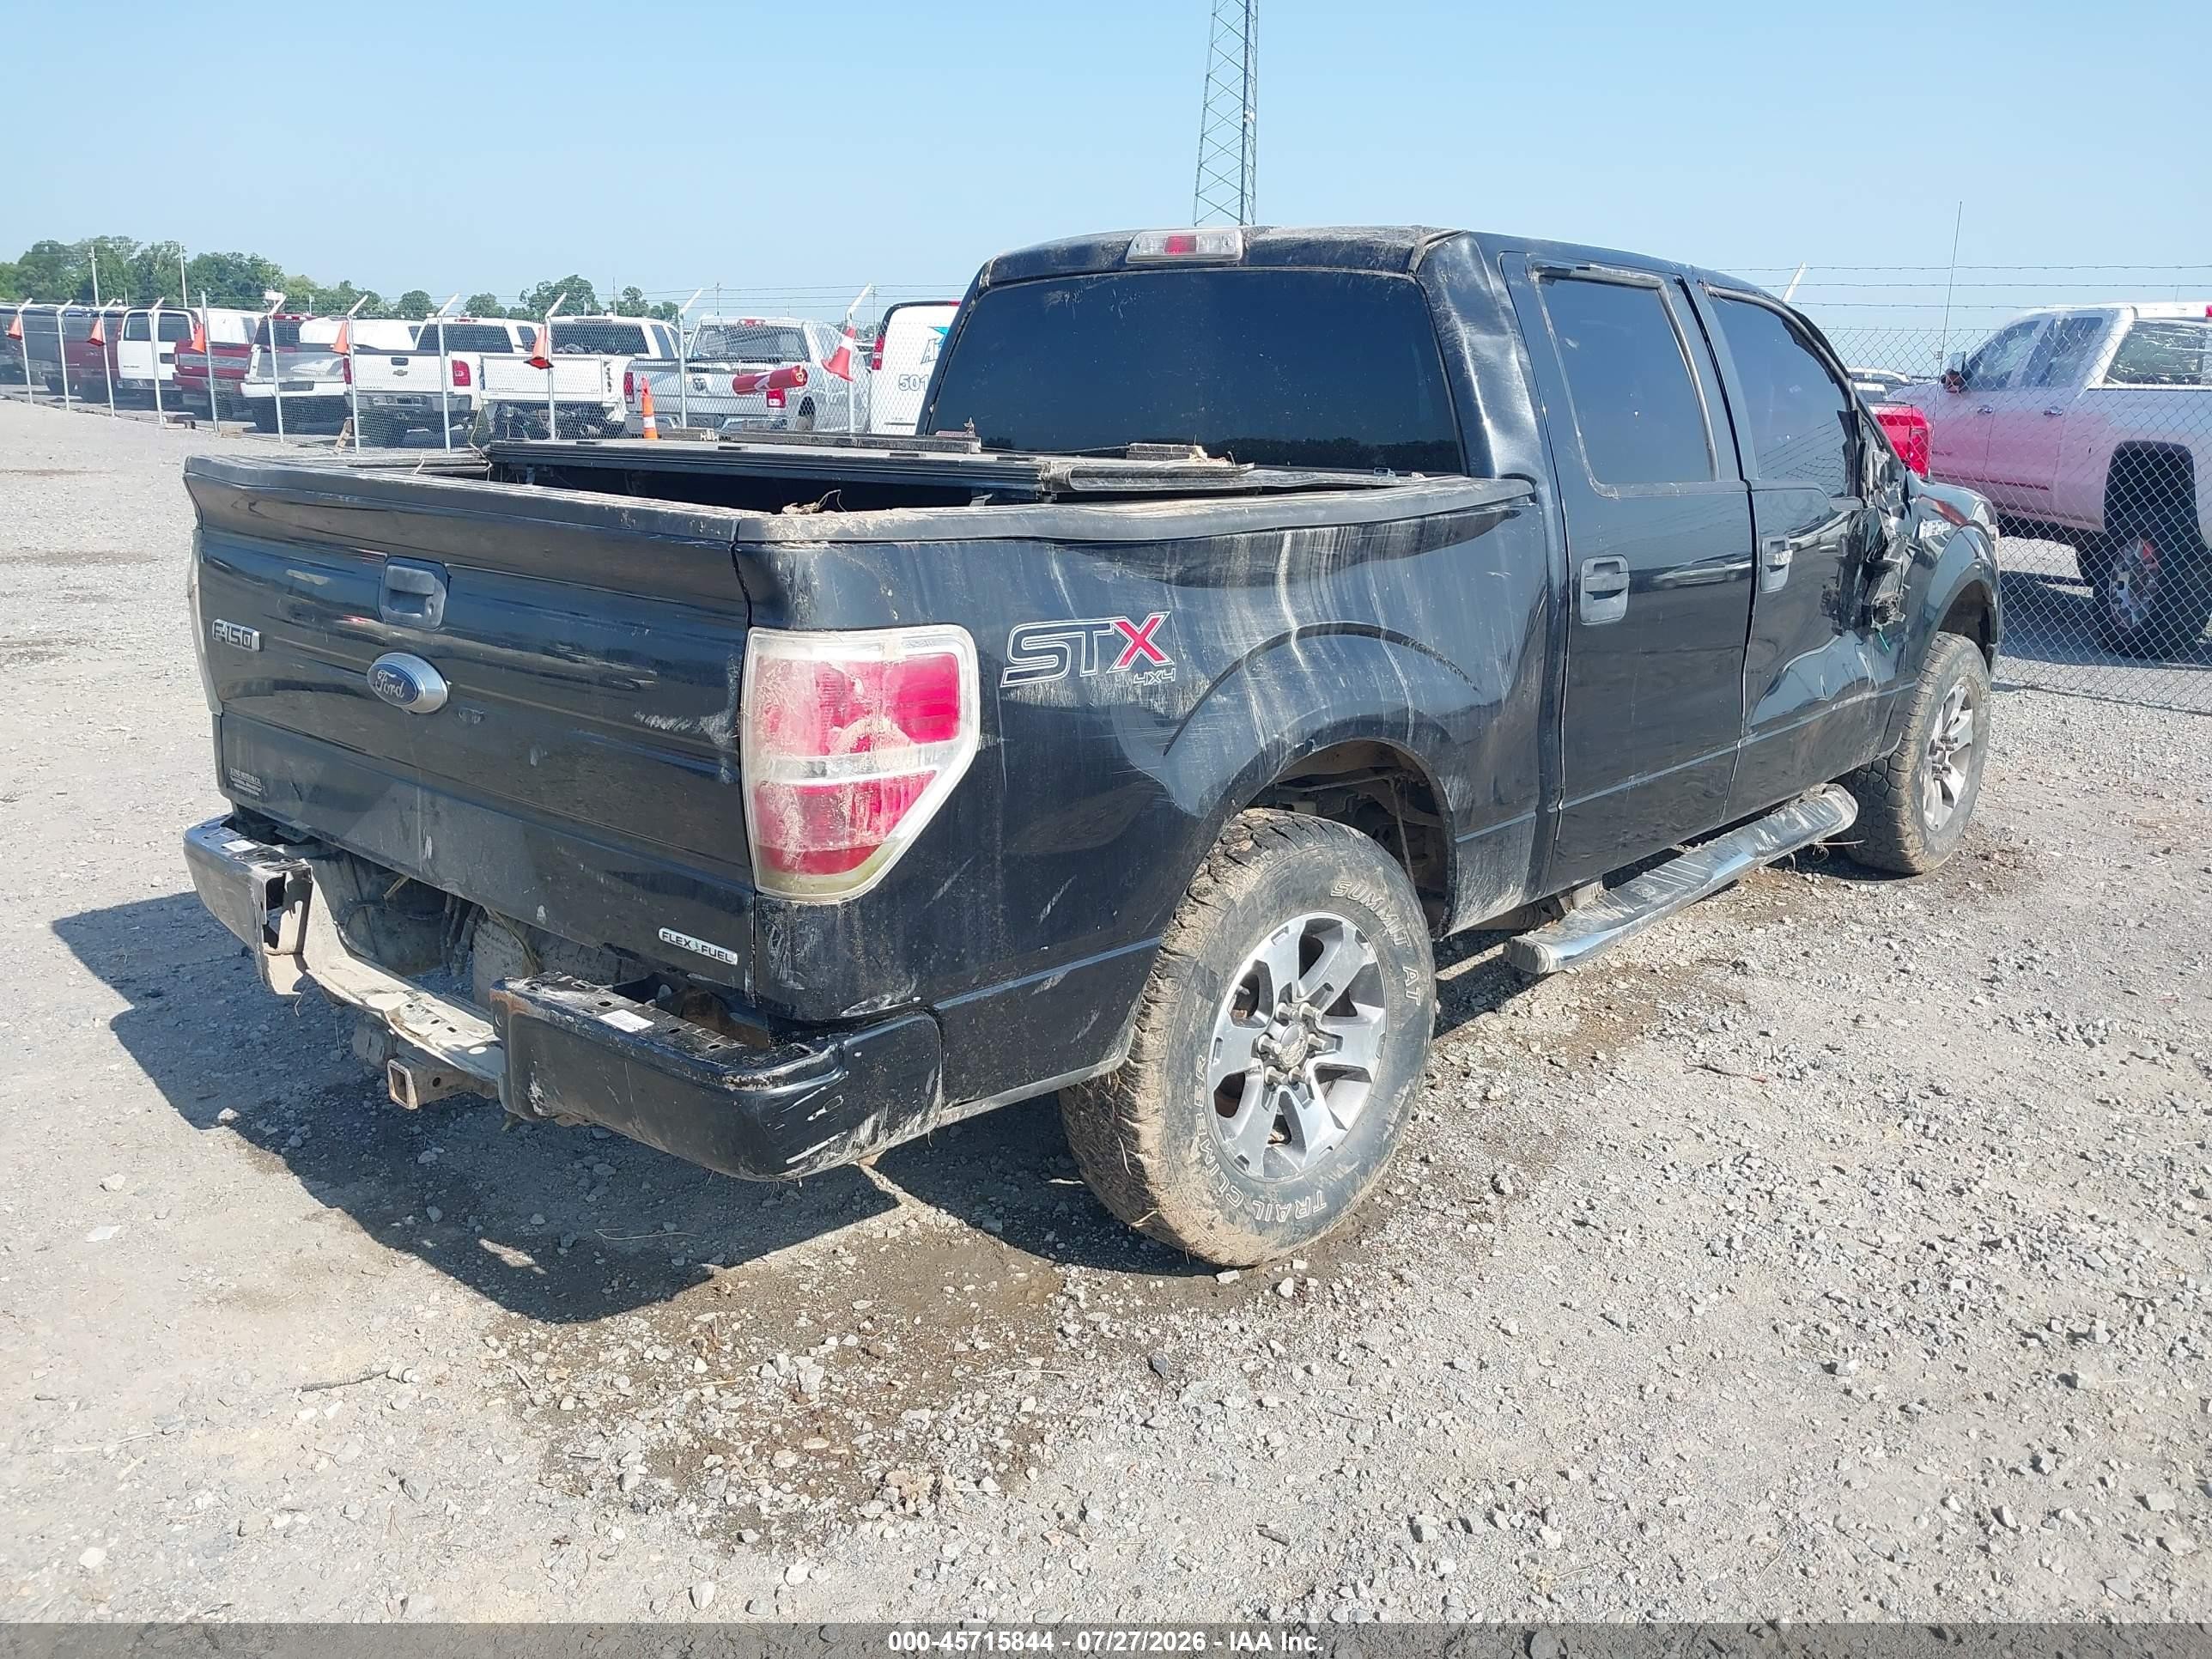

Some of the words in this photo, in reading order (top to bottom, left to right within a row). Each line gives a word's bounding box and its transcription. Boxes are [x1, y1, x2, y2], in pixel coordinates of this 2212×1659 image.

[1000, 611, 1176, 687] STX
[374, 670, 405, 698] Ford
[662, 931, 691, 949] FLEX
[701, 945, 733, 963] FUEL
[1330, 880, 1411, 947] SUMMIT
[1402, 965, 1421, 1006] AT
[1194, 1054, 1243, 1209] CLIMBER
[1253, 1190, 1326, 1223] TRAIL
